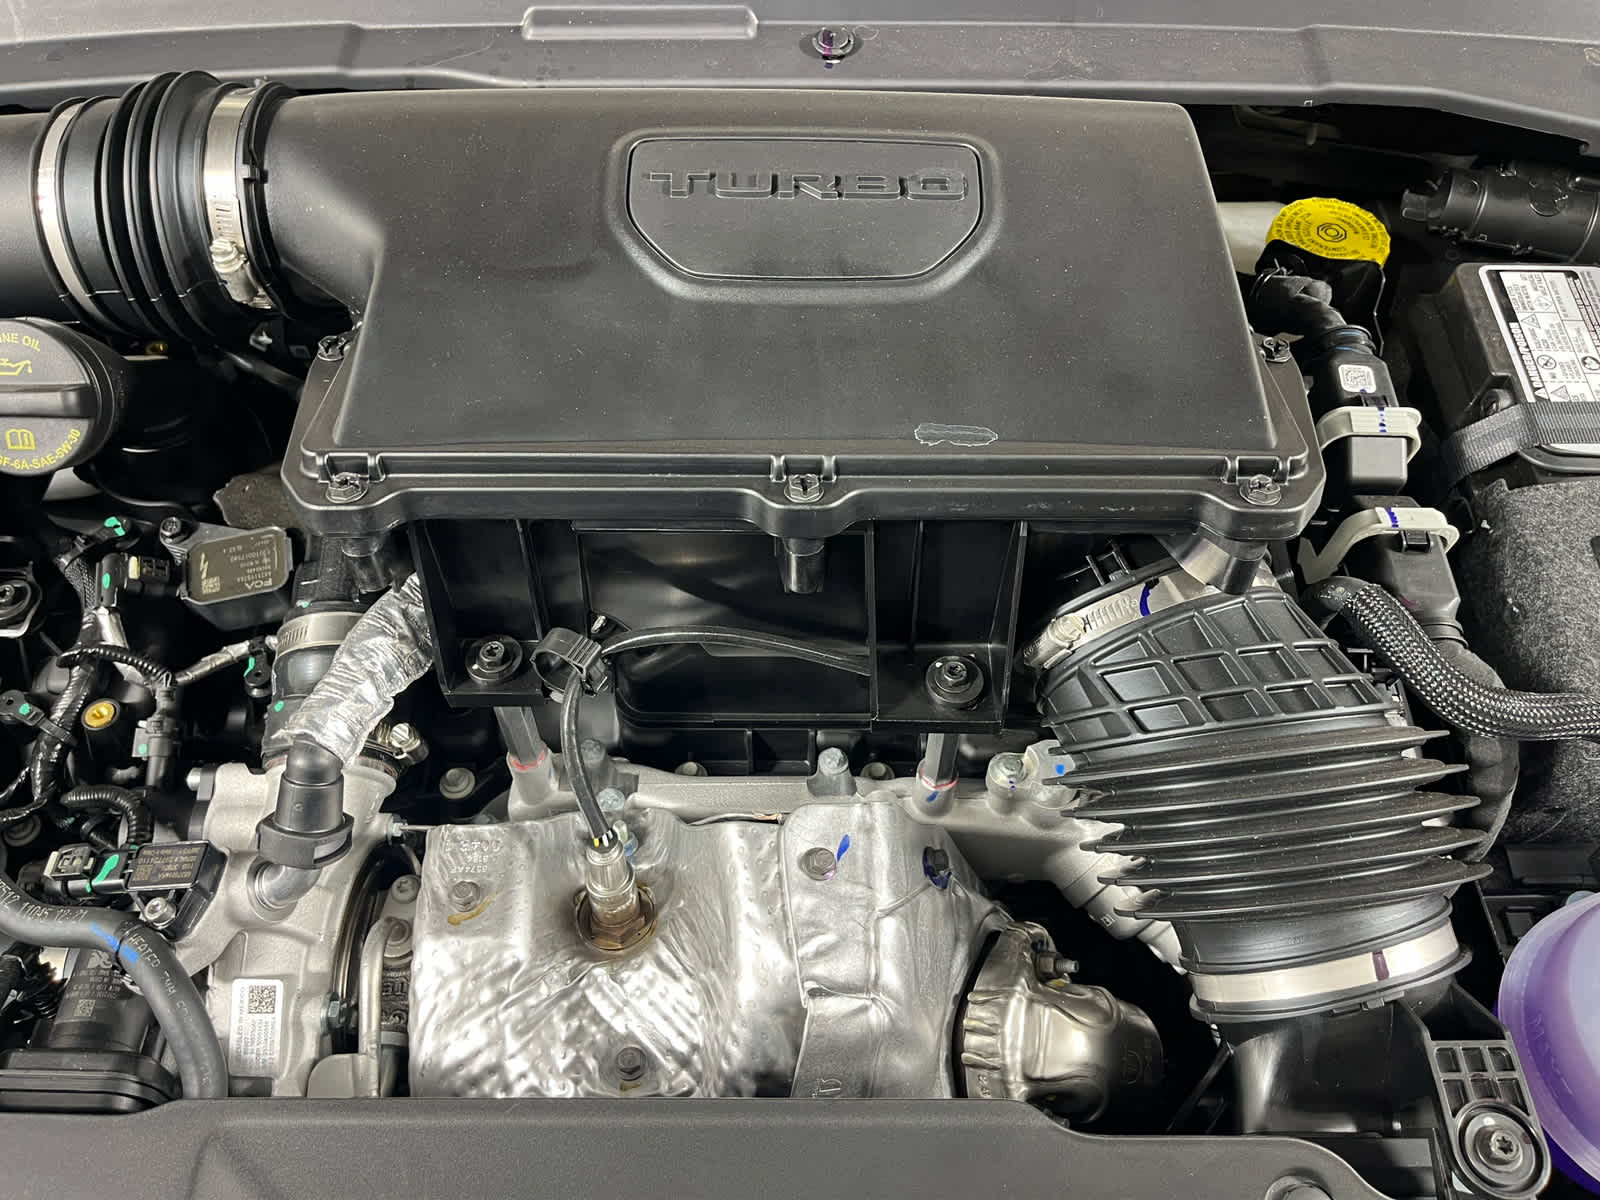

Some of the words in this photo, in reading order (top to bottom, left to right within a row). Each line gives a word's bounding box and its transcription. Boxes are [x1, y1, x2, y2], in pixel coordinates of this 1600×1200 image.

[647, 169, 968, 200] TURBO
[0, 332, 19, 344] NE
[22, 335, 41, 352] OIL
[1508, 321, 1545, 389] DANGER/POISON
[245, 577, 273, 590] FCA
